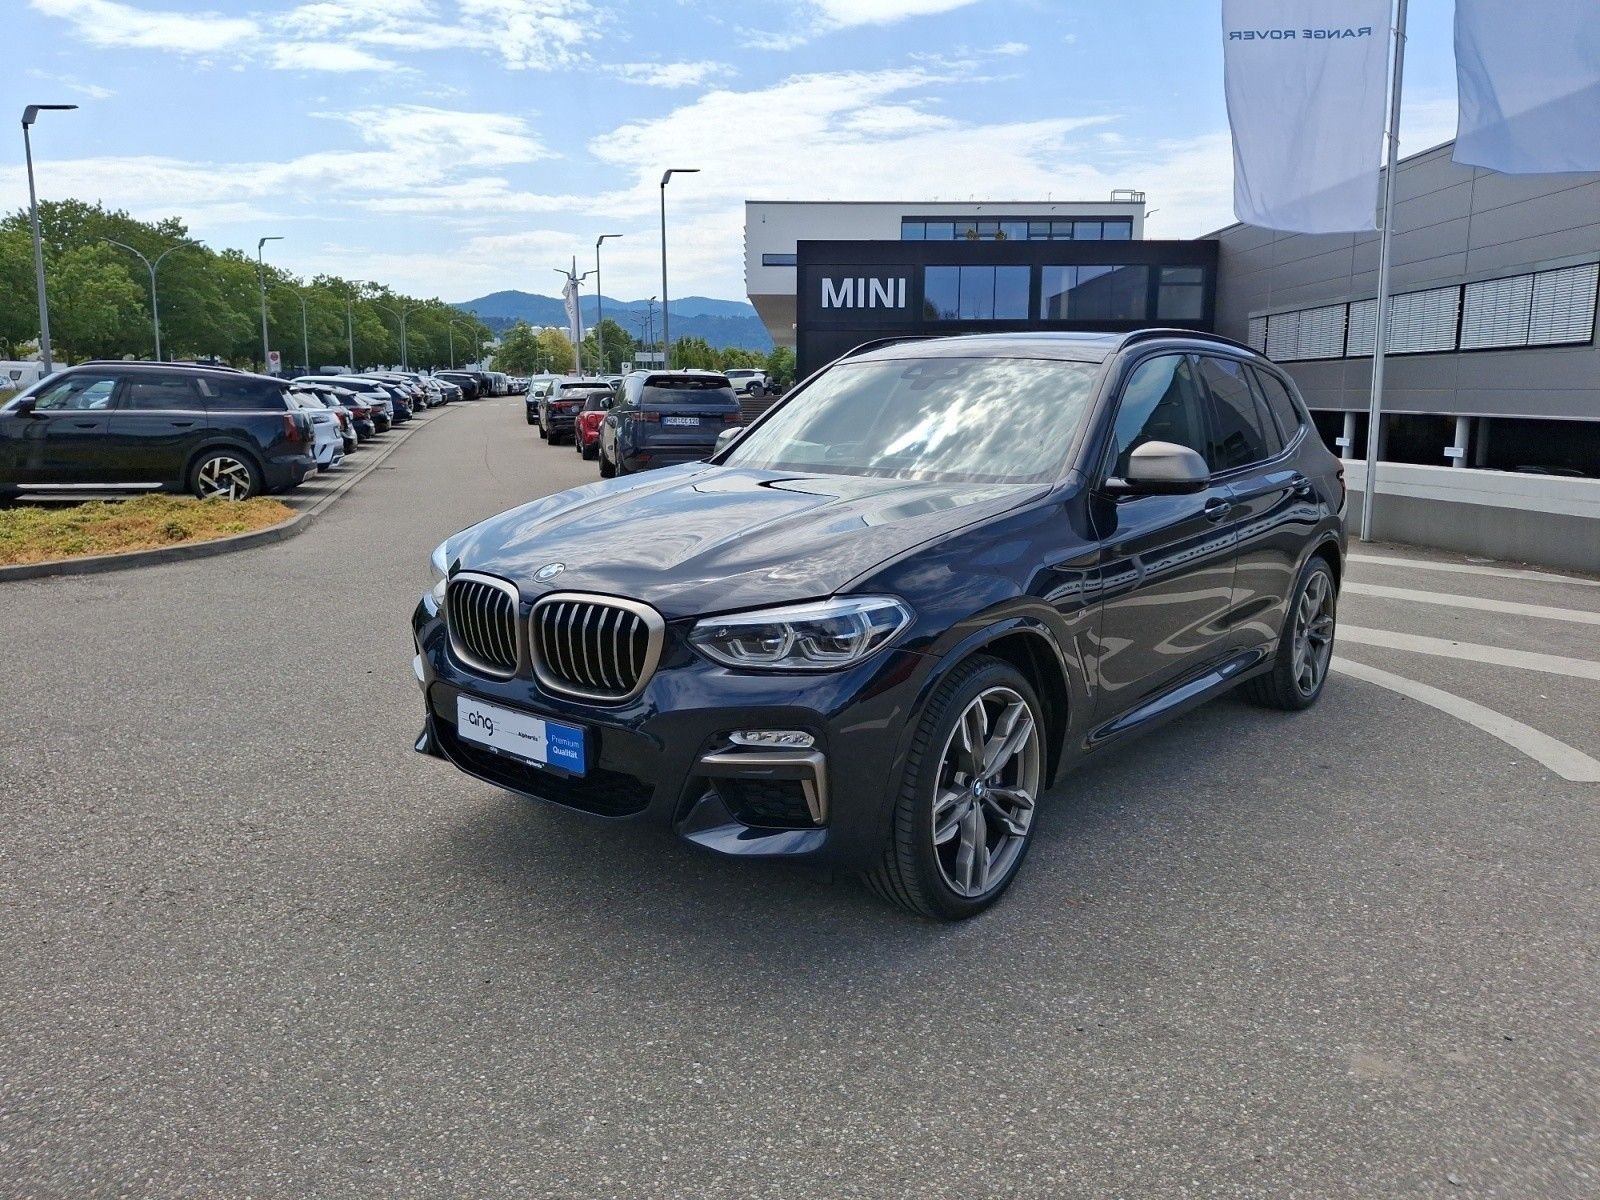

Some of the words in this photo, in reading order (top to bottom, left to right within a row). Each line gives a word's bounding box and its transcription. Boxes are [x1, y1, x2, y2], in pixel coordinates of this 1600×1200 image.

[821, 277, 906, 308] MINI
[468, 711, 494, 737] ahg
[551, 734, 580, 749] Premium
[552, 745, 578, 760] Qualität
